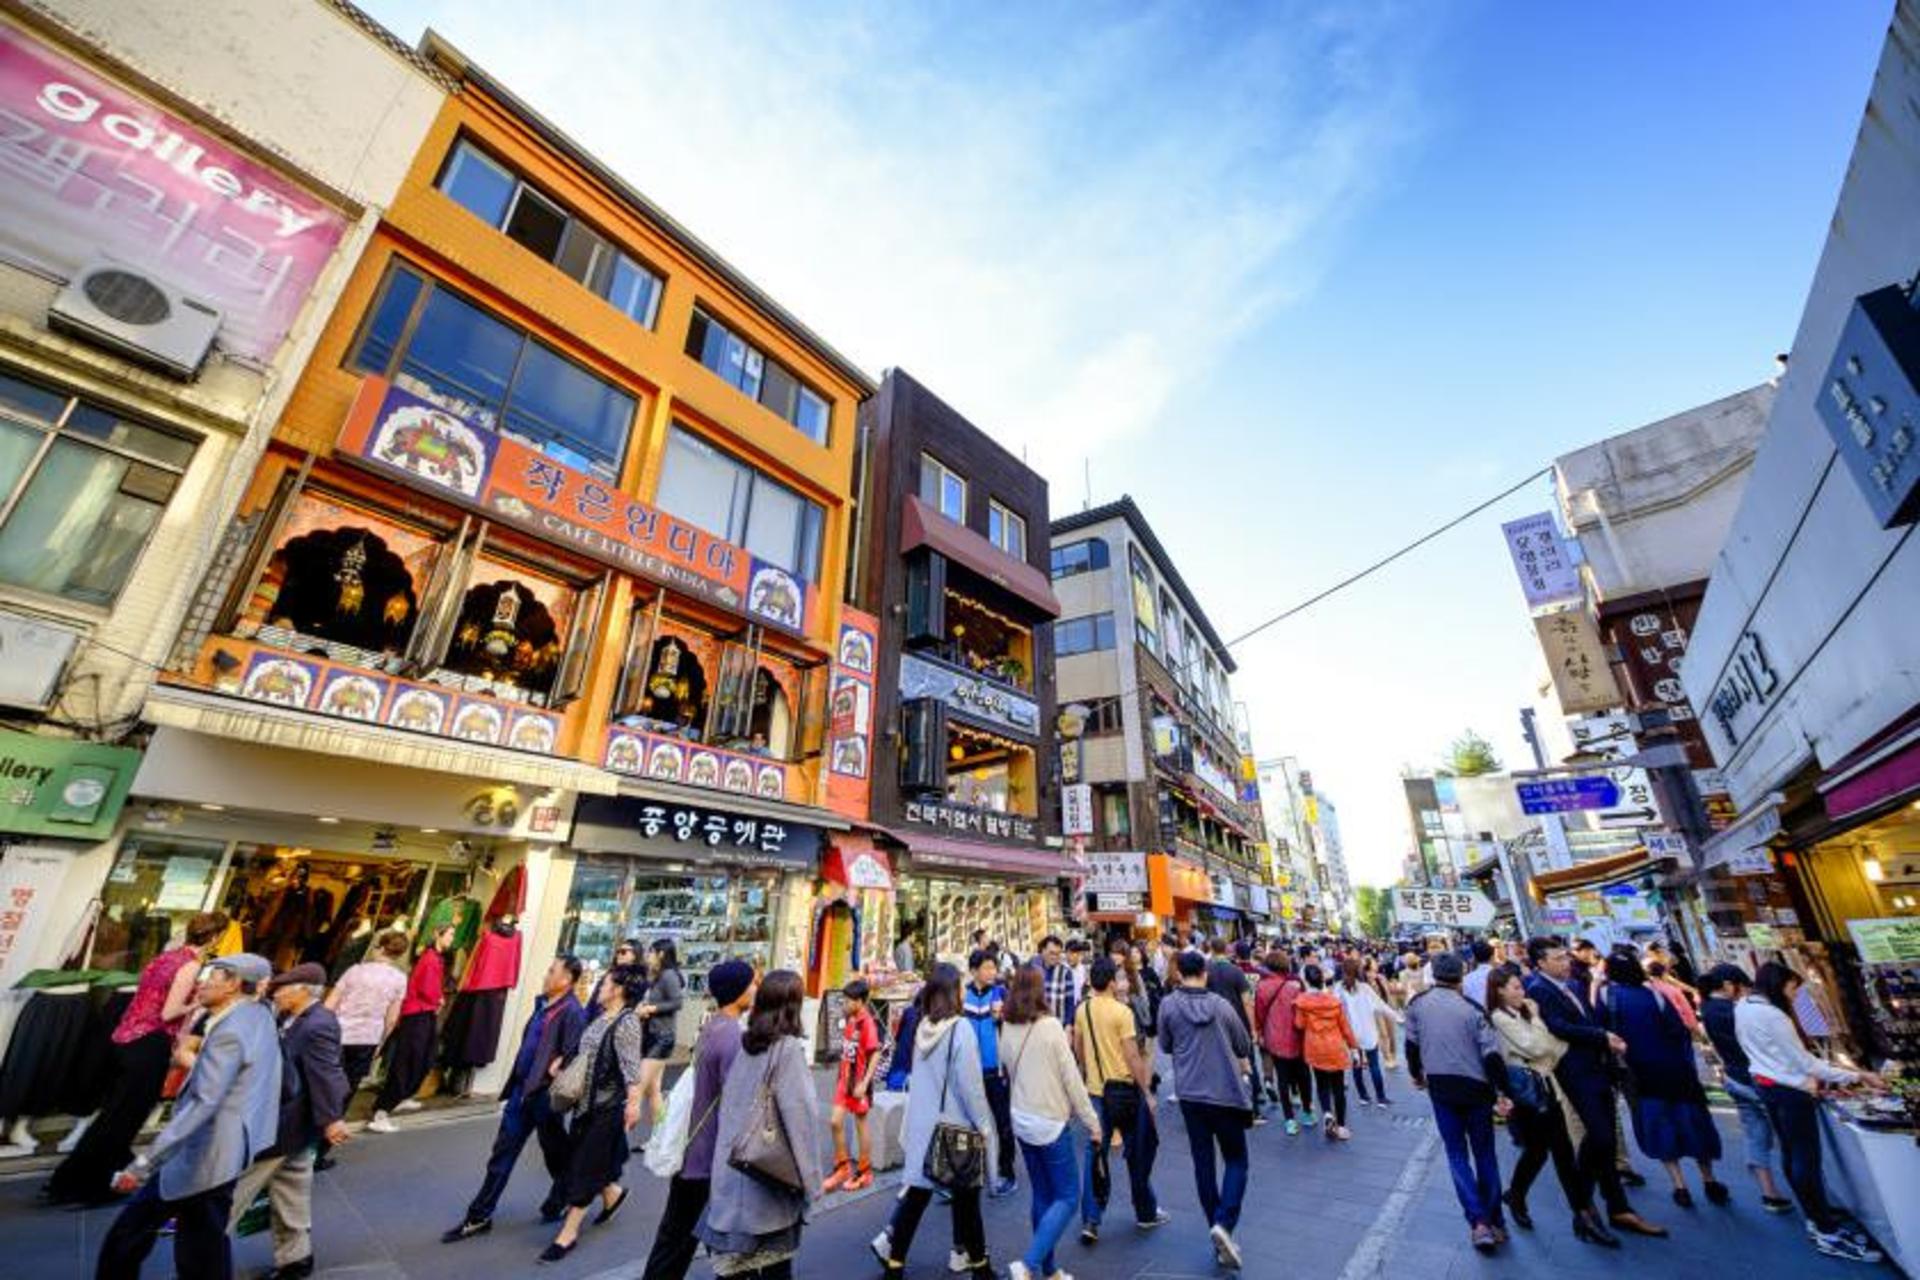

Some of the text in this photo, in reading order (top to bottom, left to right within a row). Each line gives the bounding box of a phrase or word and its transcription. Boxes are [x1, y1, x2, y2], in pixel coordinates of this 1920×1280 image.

[36, 81, 314, 237] gallery
[543, 515, 709, 592] CAFE LITTLE INDIA
[639, 806, 788, 852] 중앙공예관
